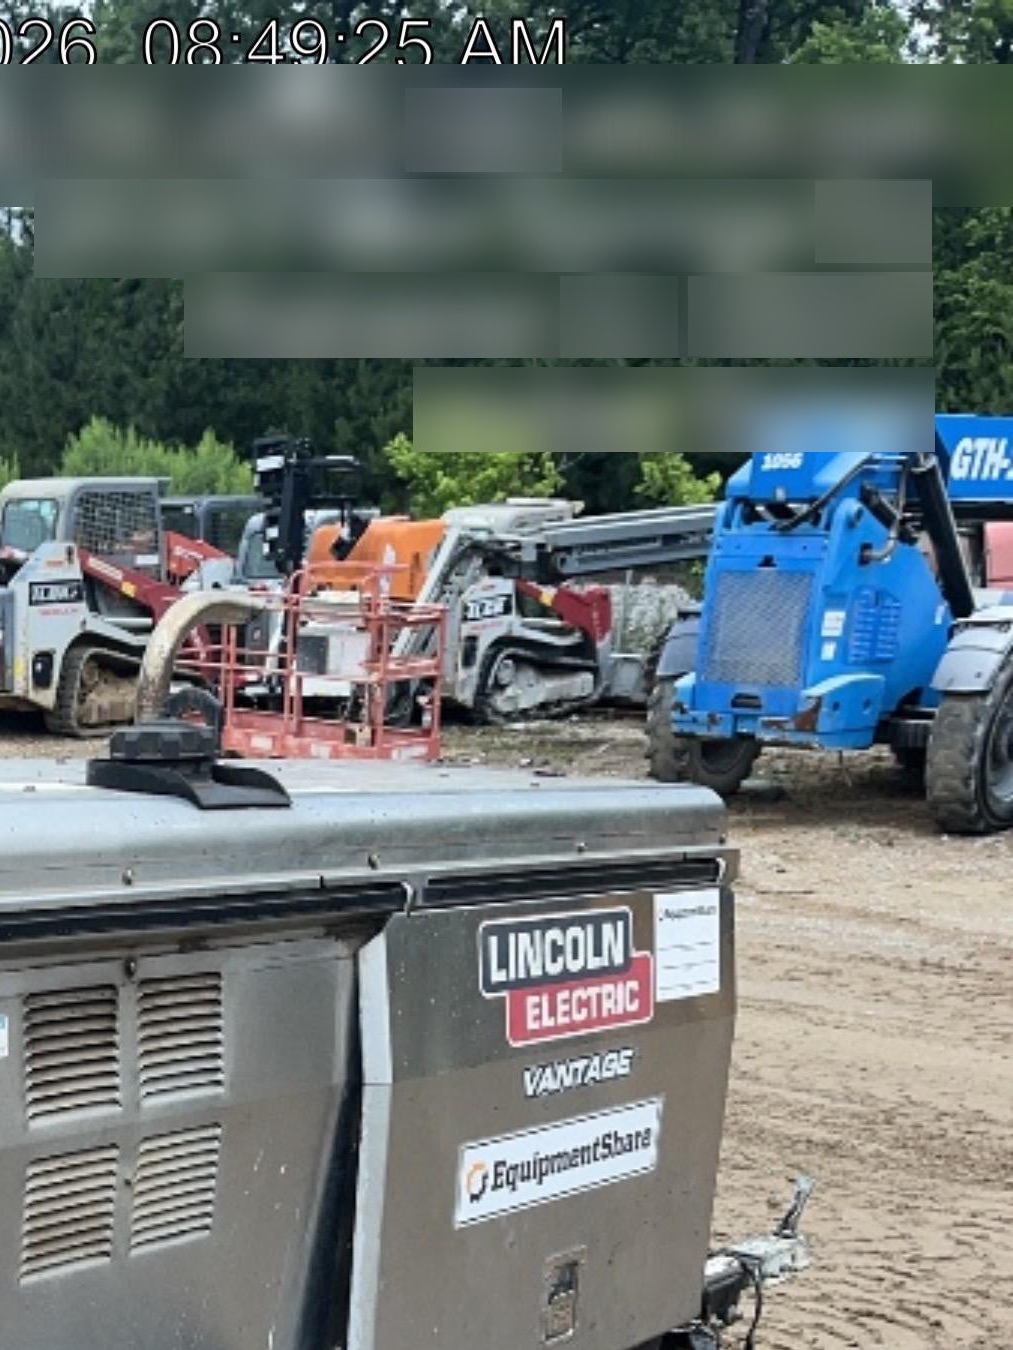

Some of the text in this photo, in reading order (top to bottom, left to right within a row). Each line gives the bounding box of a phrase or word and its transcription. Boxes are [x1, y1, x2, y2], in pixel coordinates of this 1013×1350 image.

[488, 918, 626, 984] LINCOLN
[525, 979, 640, 1031] ELECTRIC
[523, 1048, 635, 1099] VANTAGE
[490, 1126, 652, 1192] EquipmentShare
